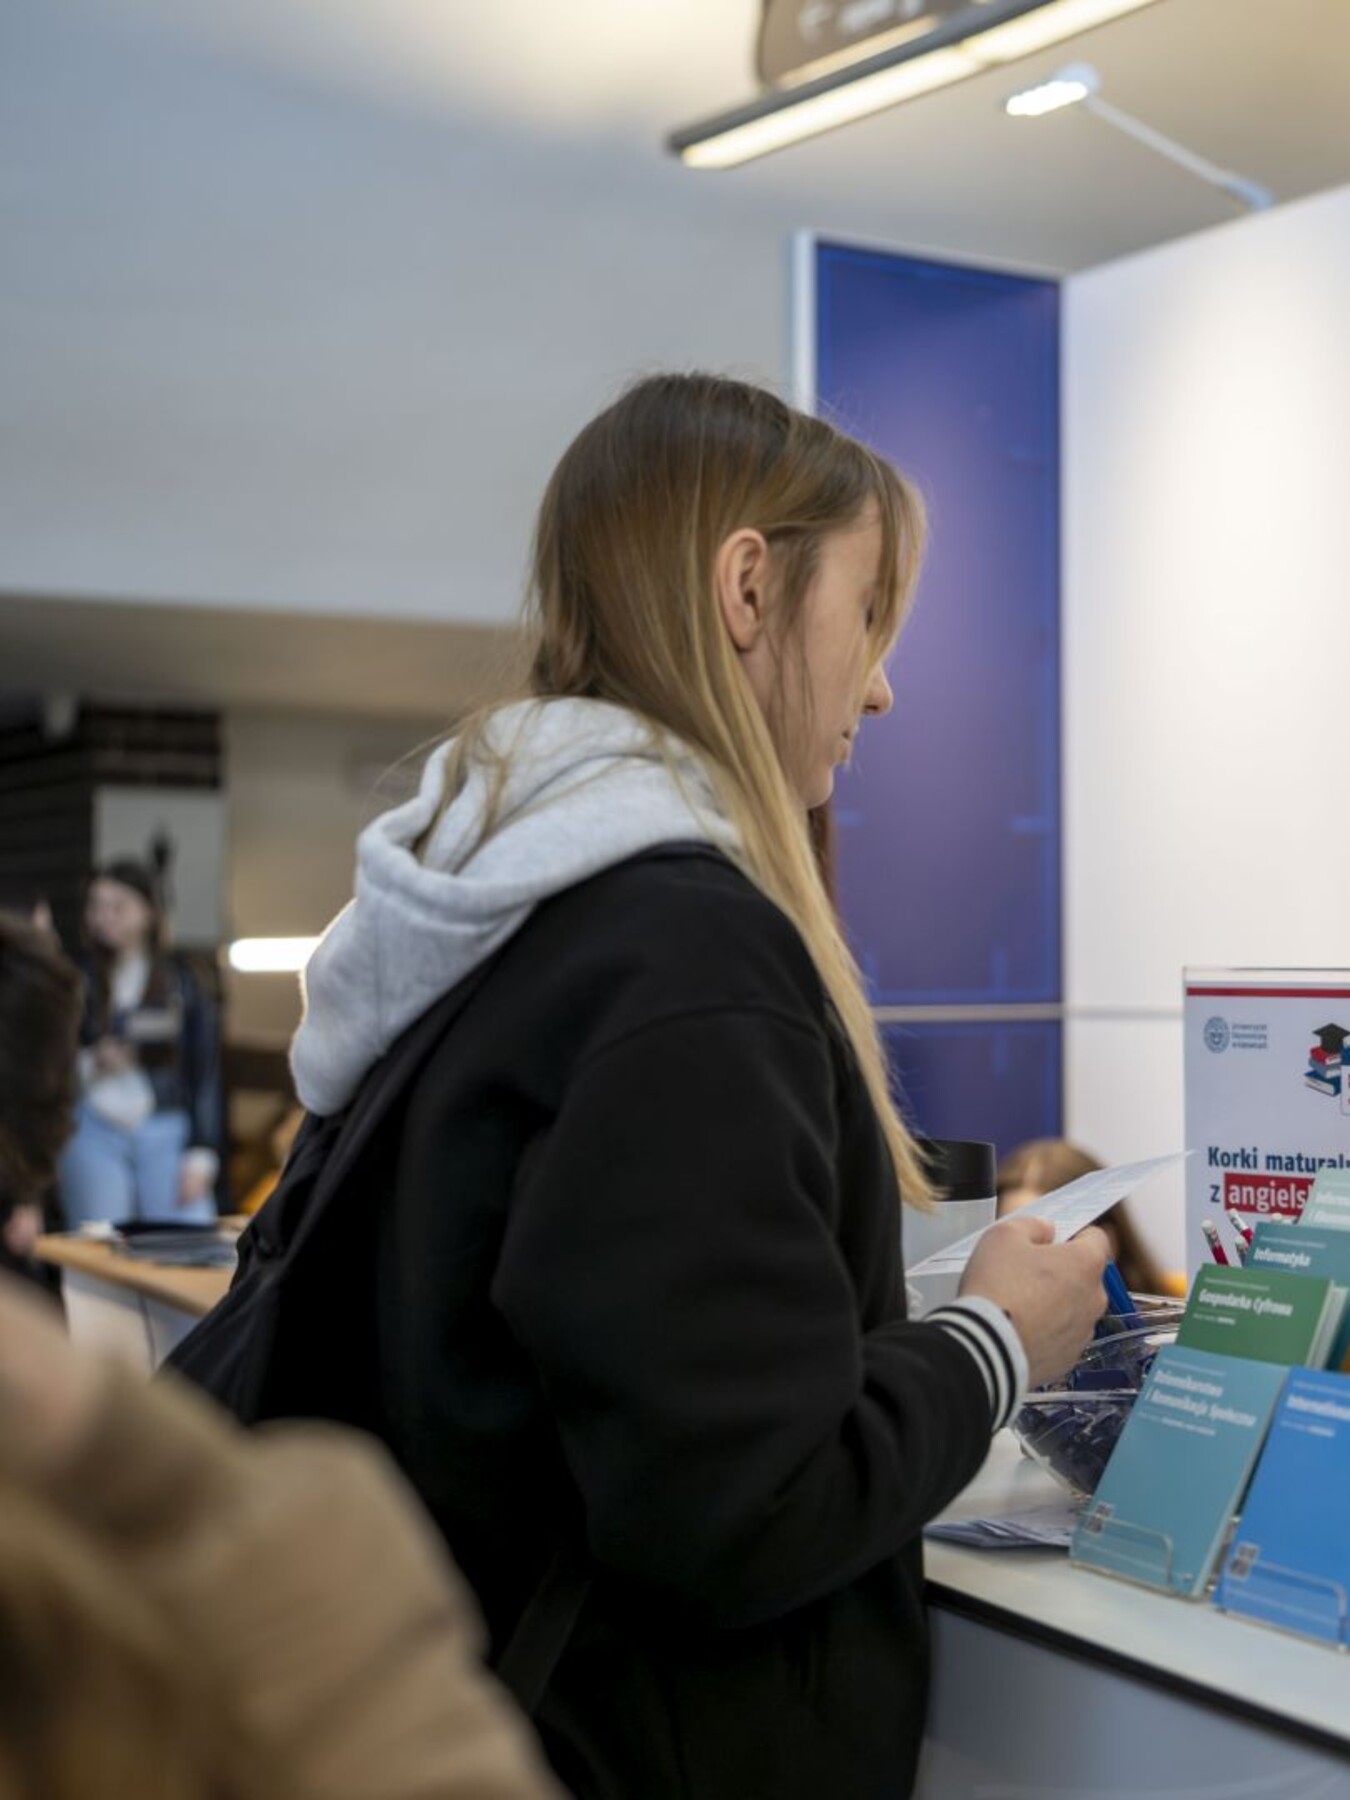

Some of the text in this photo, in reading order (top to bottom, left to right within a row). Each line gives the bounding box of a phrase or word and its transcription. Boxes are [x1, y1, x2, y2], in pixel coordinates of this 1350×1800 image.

[1208, 1146, 1258, 1169] Korki
[1209, 1179, 1312, 1213] z angiels
[1253, 1247, 1312, 1267] Informatyka
